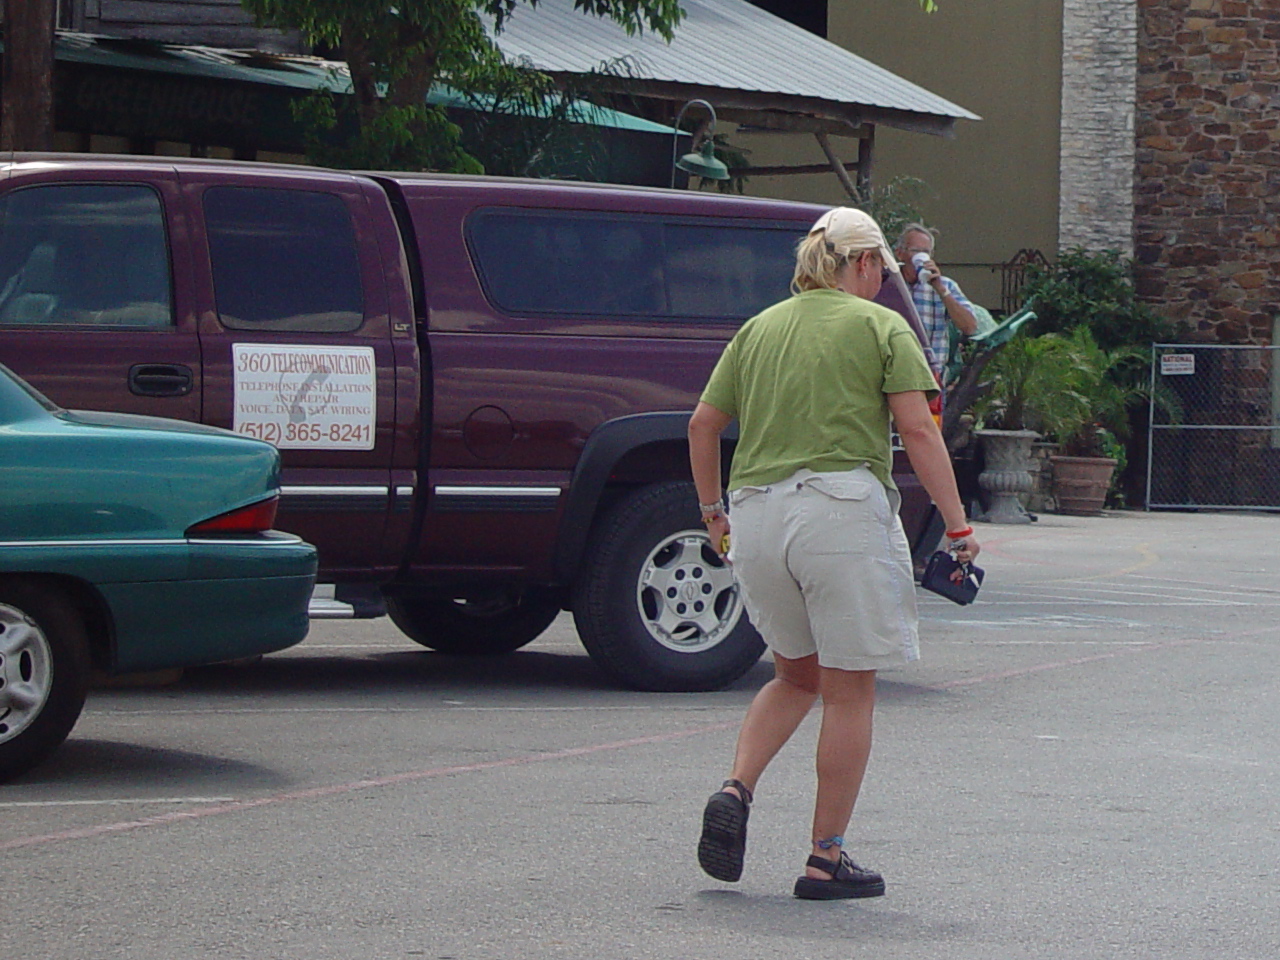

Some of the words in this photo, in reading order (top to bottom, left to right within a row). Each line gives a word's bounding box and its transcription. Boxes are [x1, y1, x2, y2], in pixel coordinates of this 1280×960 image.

[77, 74, 259, 126] GREENHOUSE
[240, 381, 298, 391] TELEPHONE
[300, 382, 372, 393] INSTALLATION
[272, 393, 298, 403] AND
[300, 394, 339, 403] REPAIR
[330, 405, 371, 415] WIRING
[238, 422, 282, 445] (512)
[285, 422, 371, 442] 365-8241
